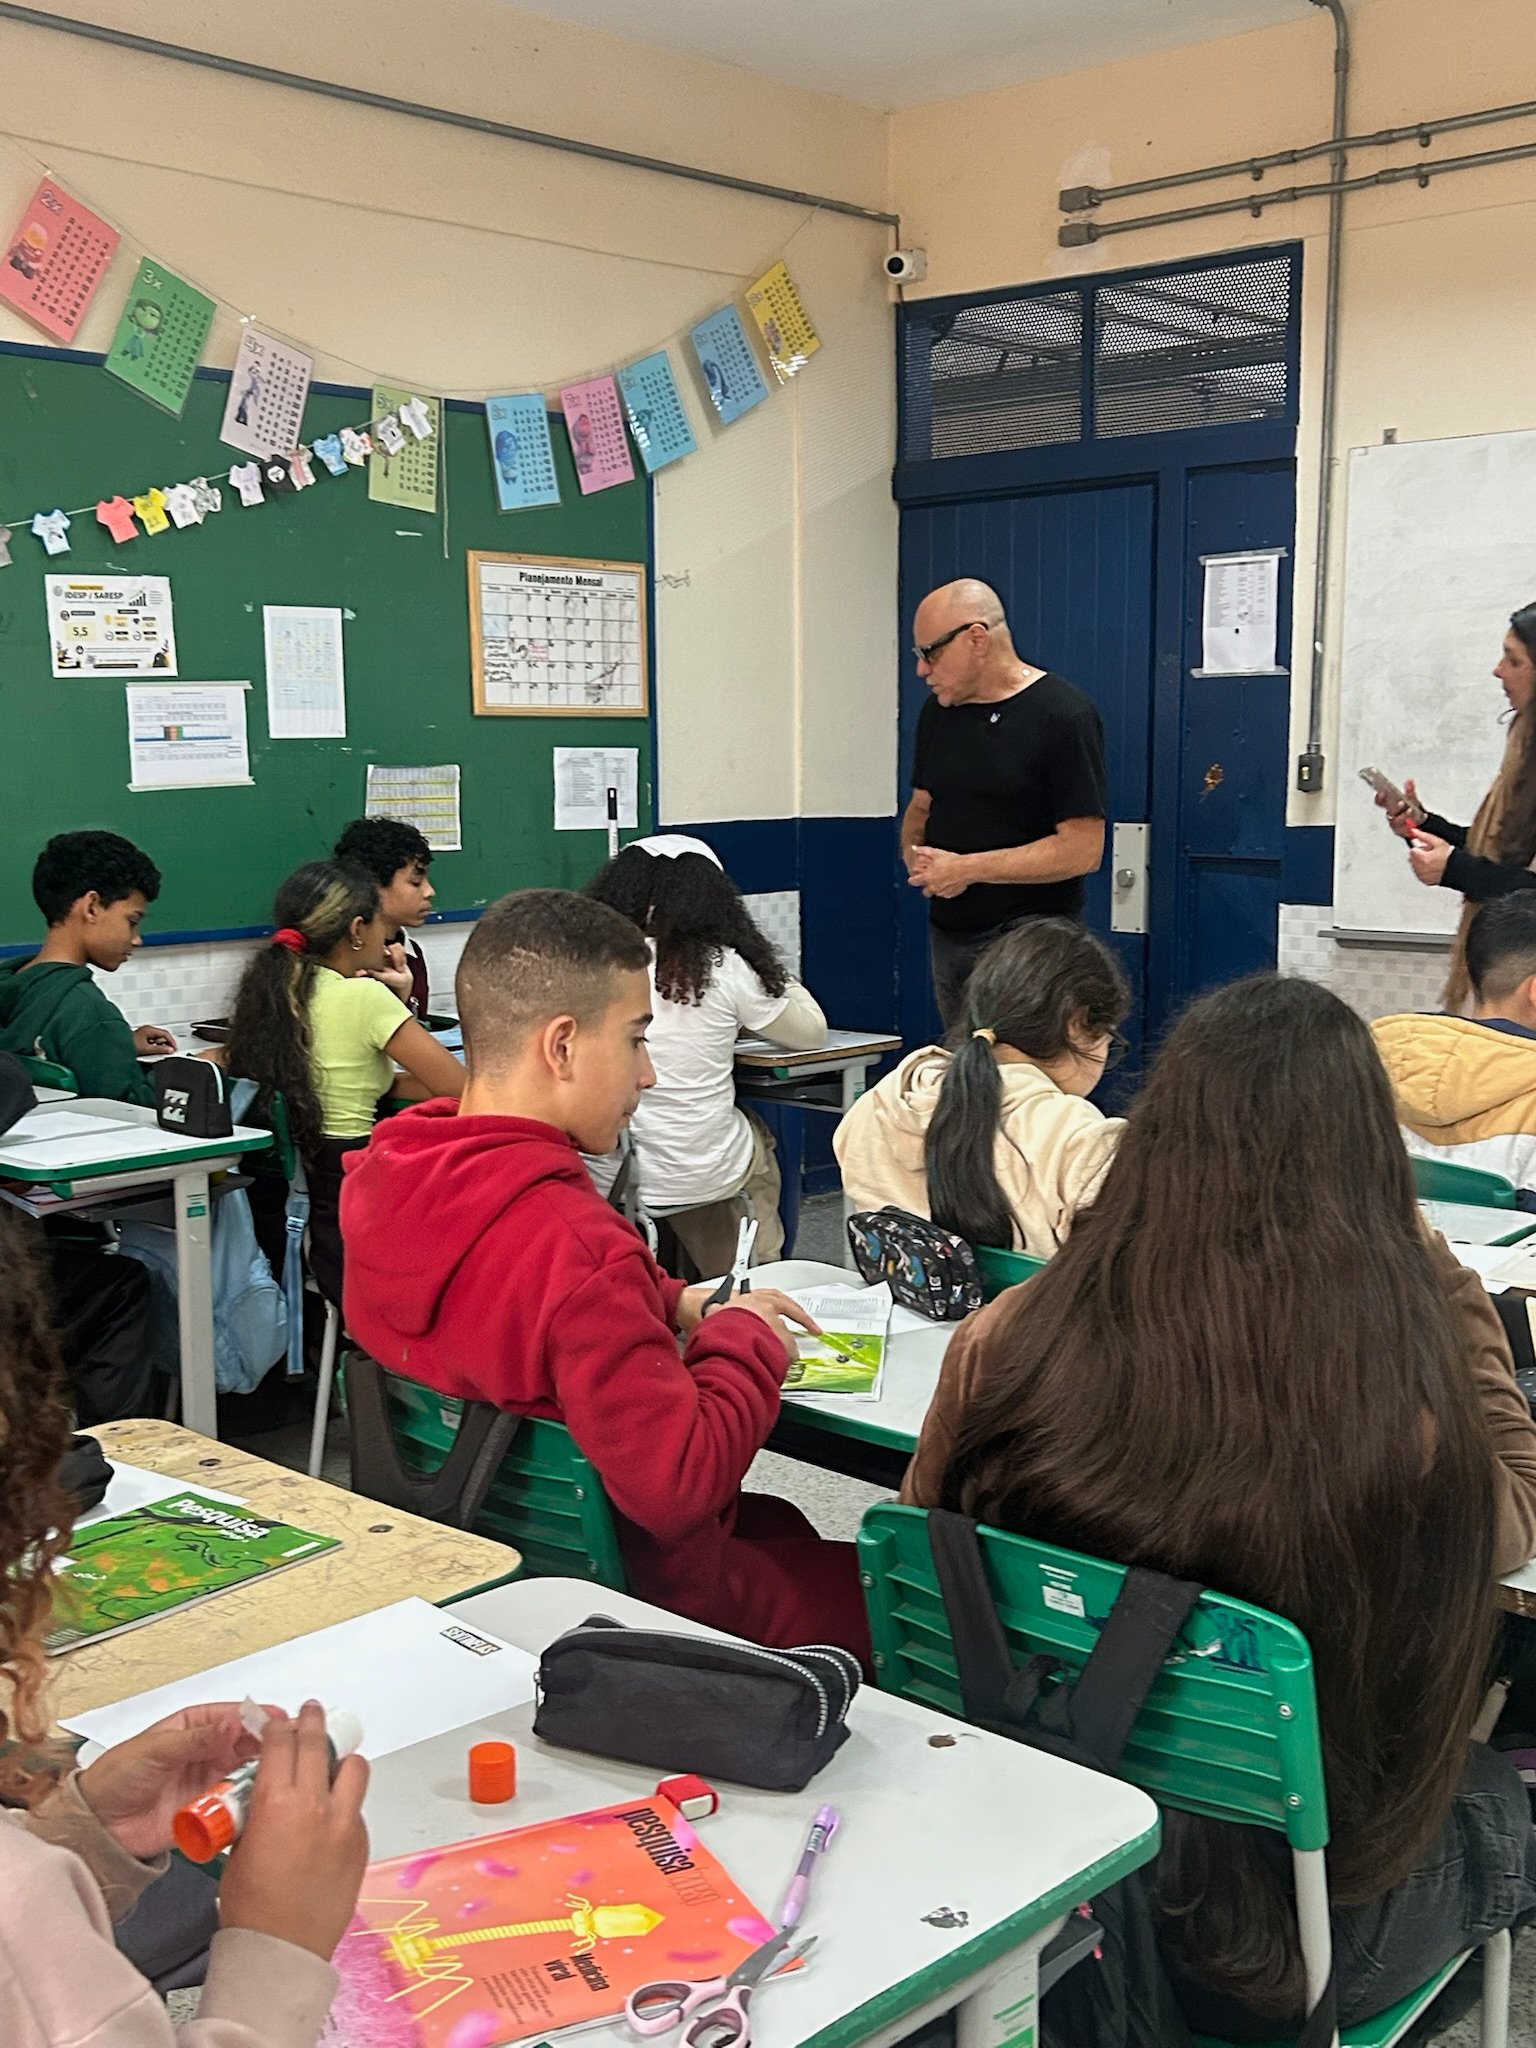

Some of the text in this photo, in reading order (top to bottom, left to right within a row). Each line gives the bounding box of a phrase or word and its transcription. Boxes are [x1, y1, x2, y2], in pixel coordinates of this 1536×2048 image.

[142, 268, 164, 291] 3x
[519, 572, 603, 586] Planejamento Mensal
[73, 627, 88, 637] 5,5
[167, 1499, 270, 1539] Pesquisa
[614, 1807, 695, 1875] pesquisa
[543, 1959, 577, 1981] viral
[569, 1953, 610, 1991] Medicina
